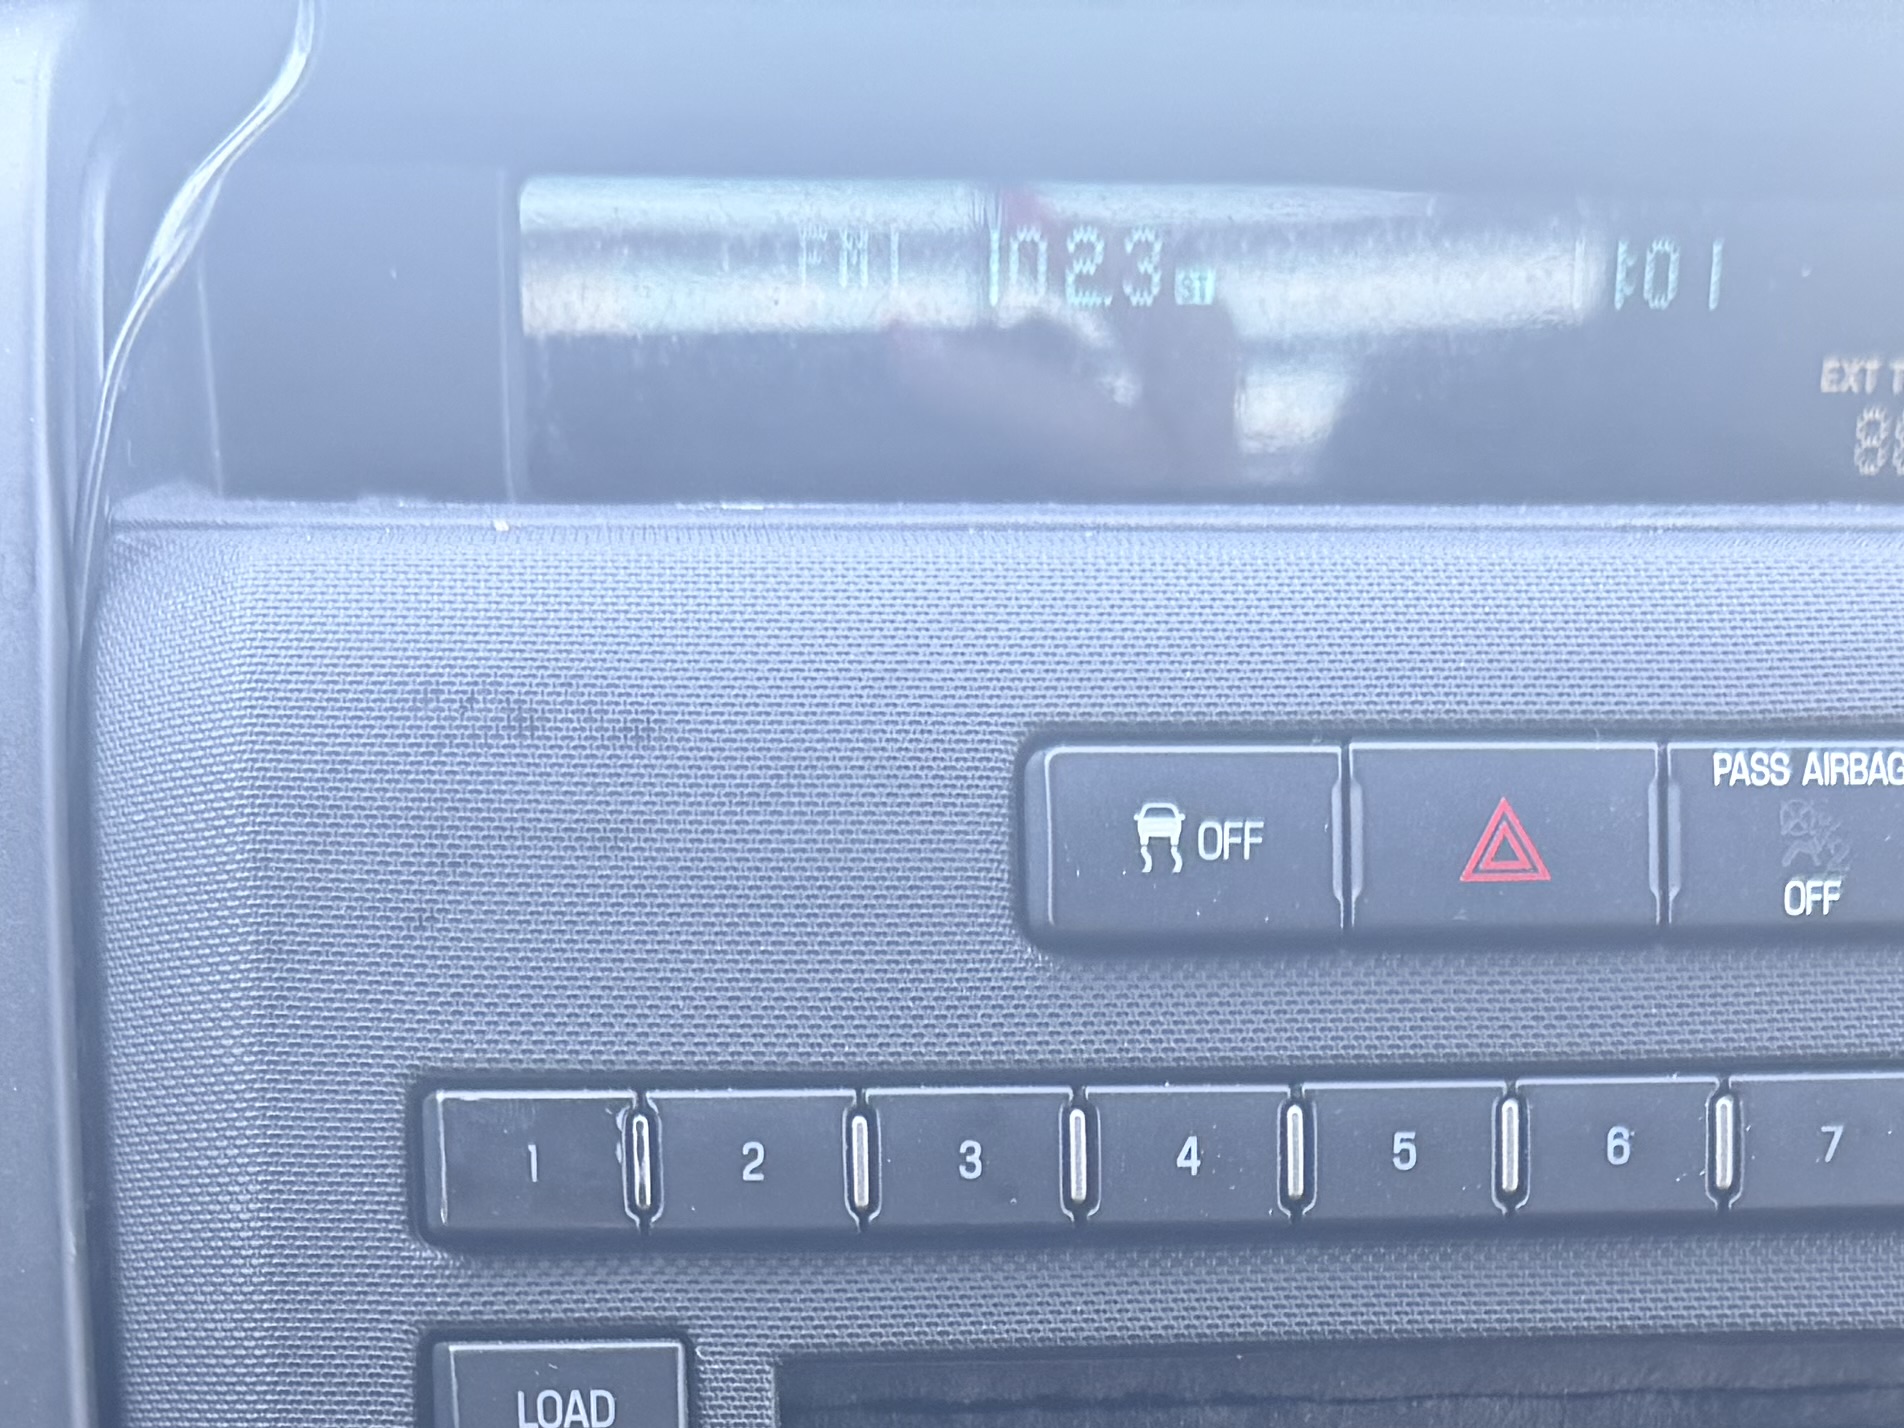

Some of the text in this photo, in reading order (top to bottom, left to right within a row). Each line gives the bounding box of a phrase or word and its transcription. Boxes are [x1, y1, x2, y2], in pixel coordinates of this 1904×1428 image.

[1819, 354, 1882, 395] EXT
[1712, 752, 1791, 787] PASS
[1197, 820, 1265, 861] OFF
[1783, 879, 1842, 917] OFF
[527, 1144, 538, 1183] 1
[742, 1141, 765, 1181] 2
[958, 1140, 982, 1180] 3
[1176, 1135, 1201, 1176] 4
[1392, 1131, 1417, 1171] 5
[1607, 1126, 1632, 1165] 6
[1820, 1124, 1845, 1163] 7
